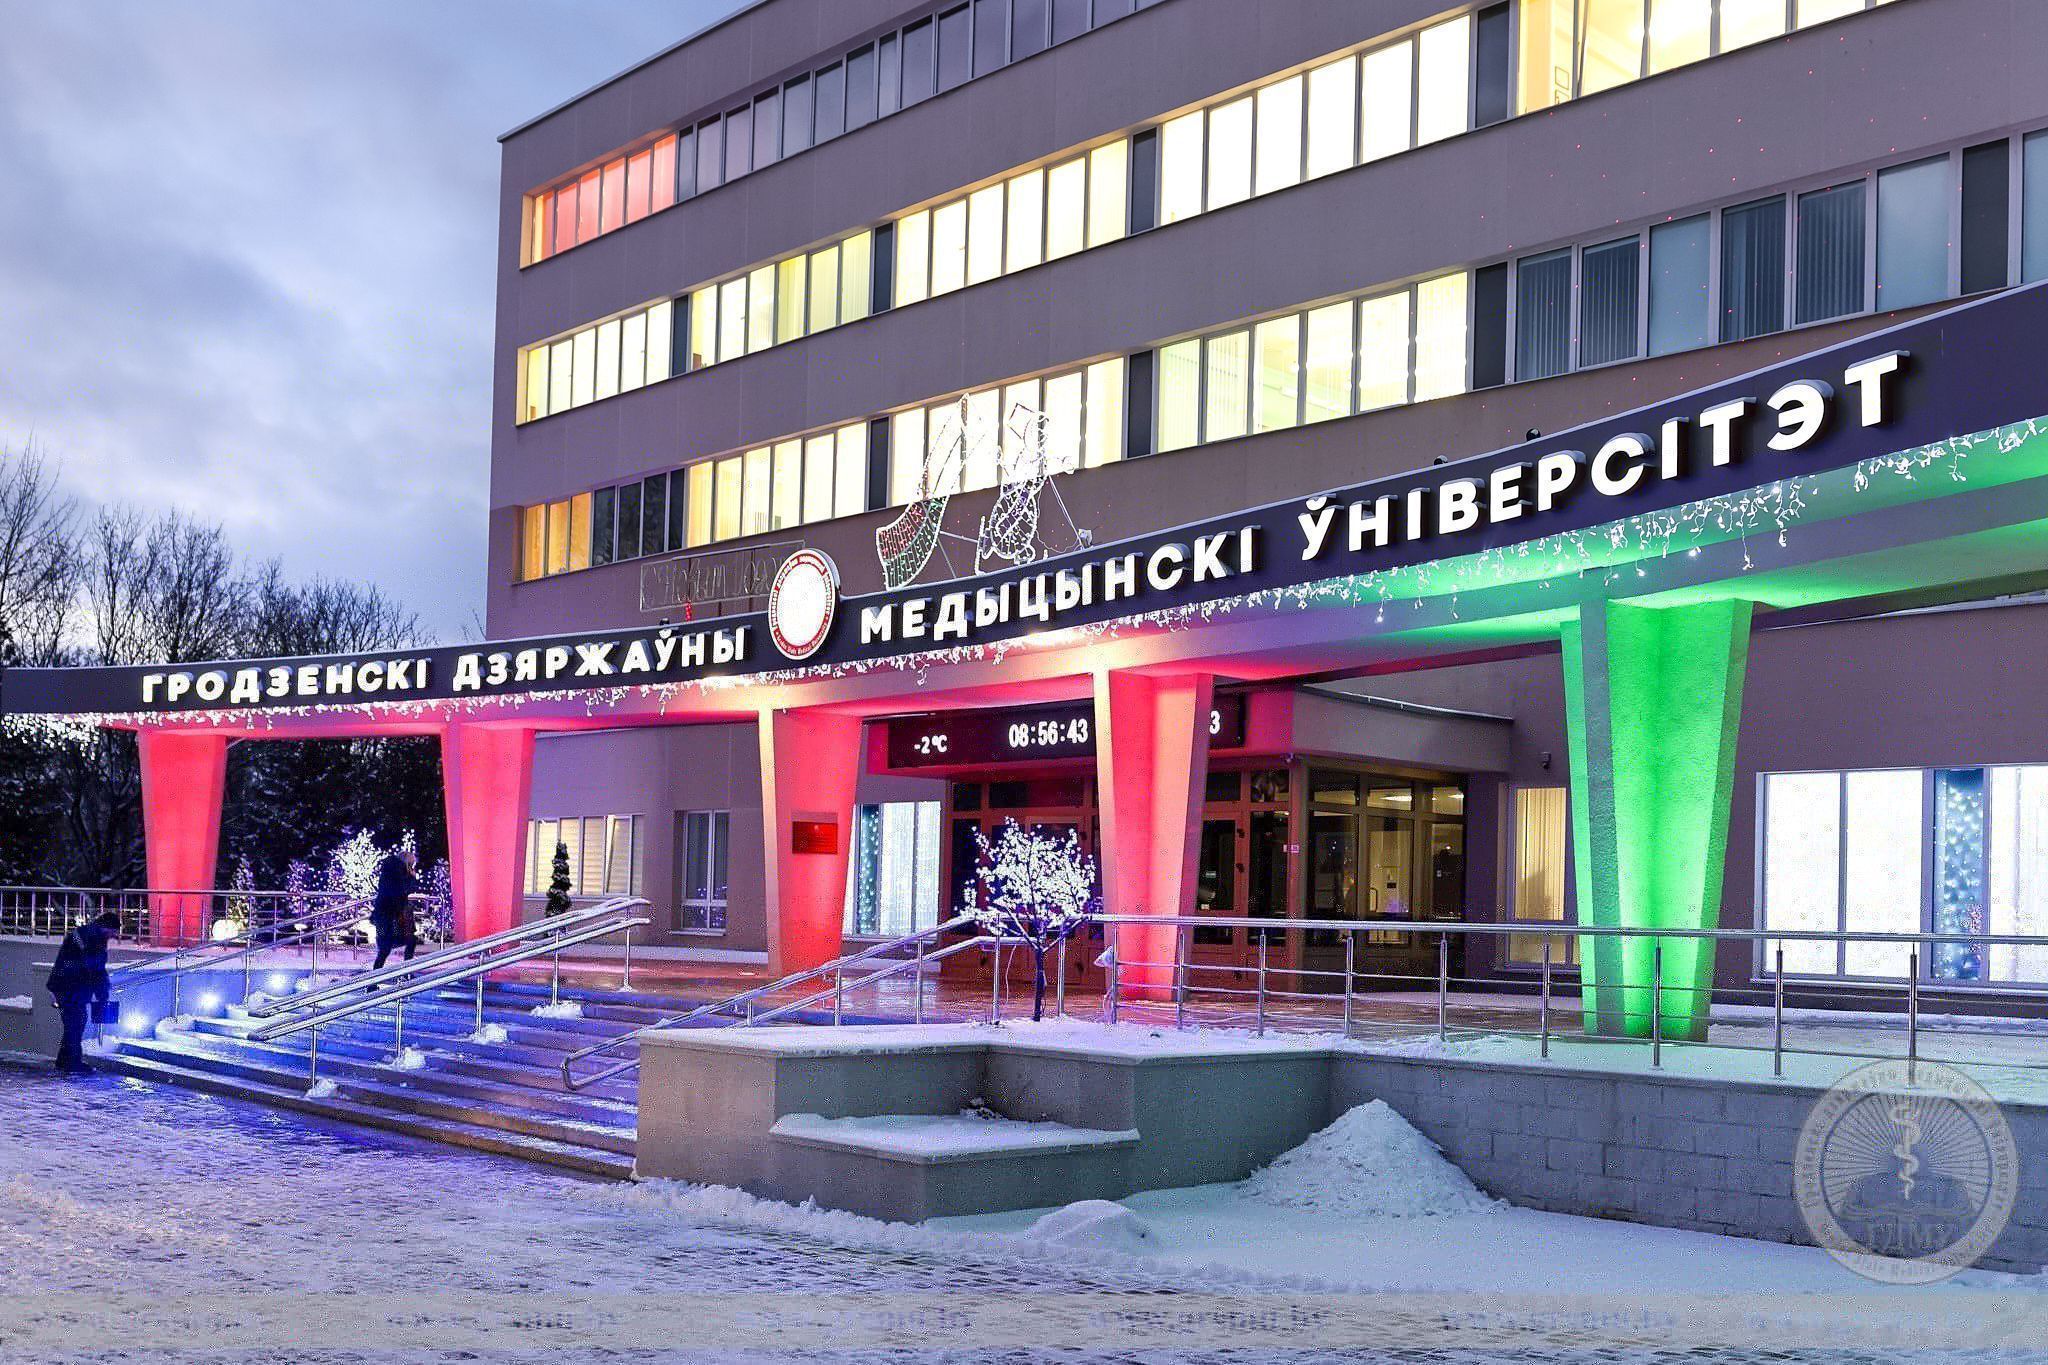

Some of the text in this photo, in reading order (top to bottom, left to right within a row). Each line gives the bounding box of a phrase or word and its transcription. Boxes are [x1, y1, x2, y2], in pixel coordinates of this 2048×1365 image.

[142, 659, 427, 703] ГРОДЗЕНСКІ
[452, 627, 746, 692] ДЗЯРЖАЎНЫ
[861, 527, 1254, 644] МЕДЫЦЫНСКІ
[1298, 354, 1899, 561] ЎНІВЕРСІТЭТ
[1008, 718, 1089, 748] 08:56:43
